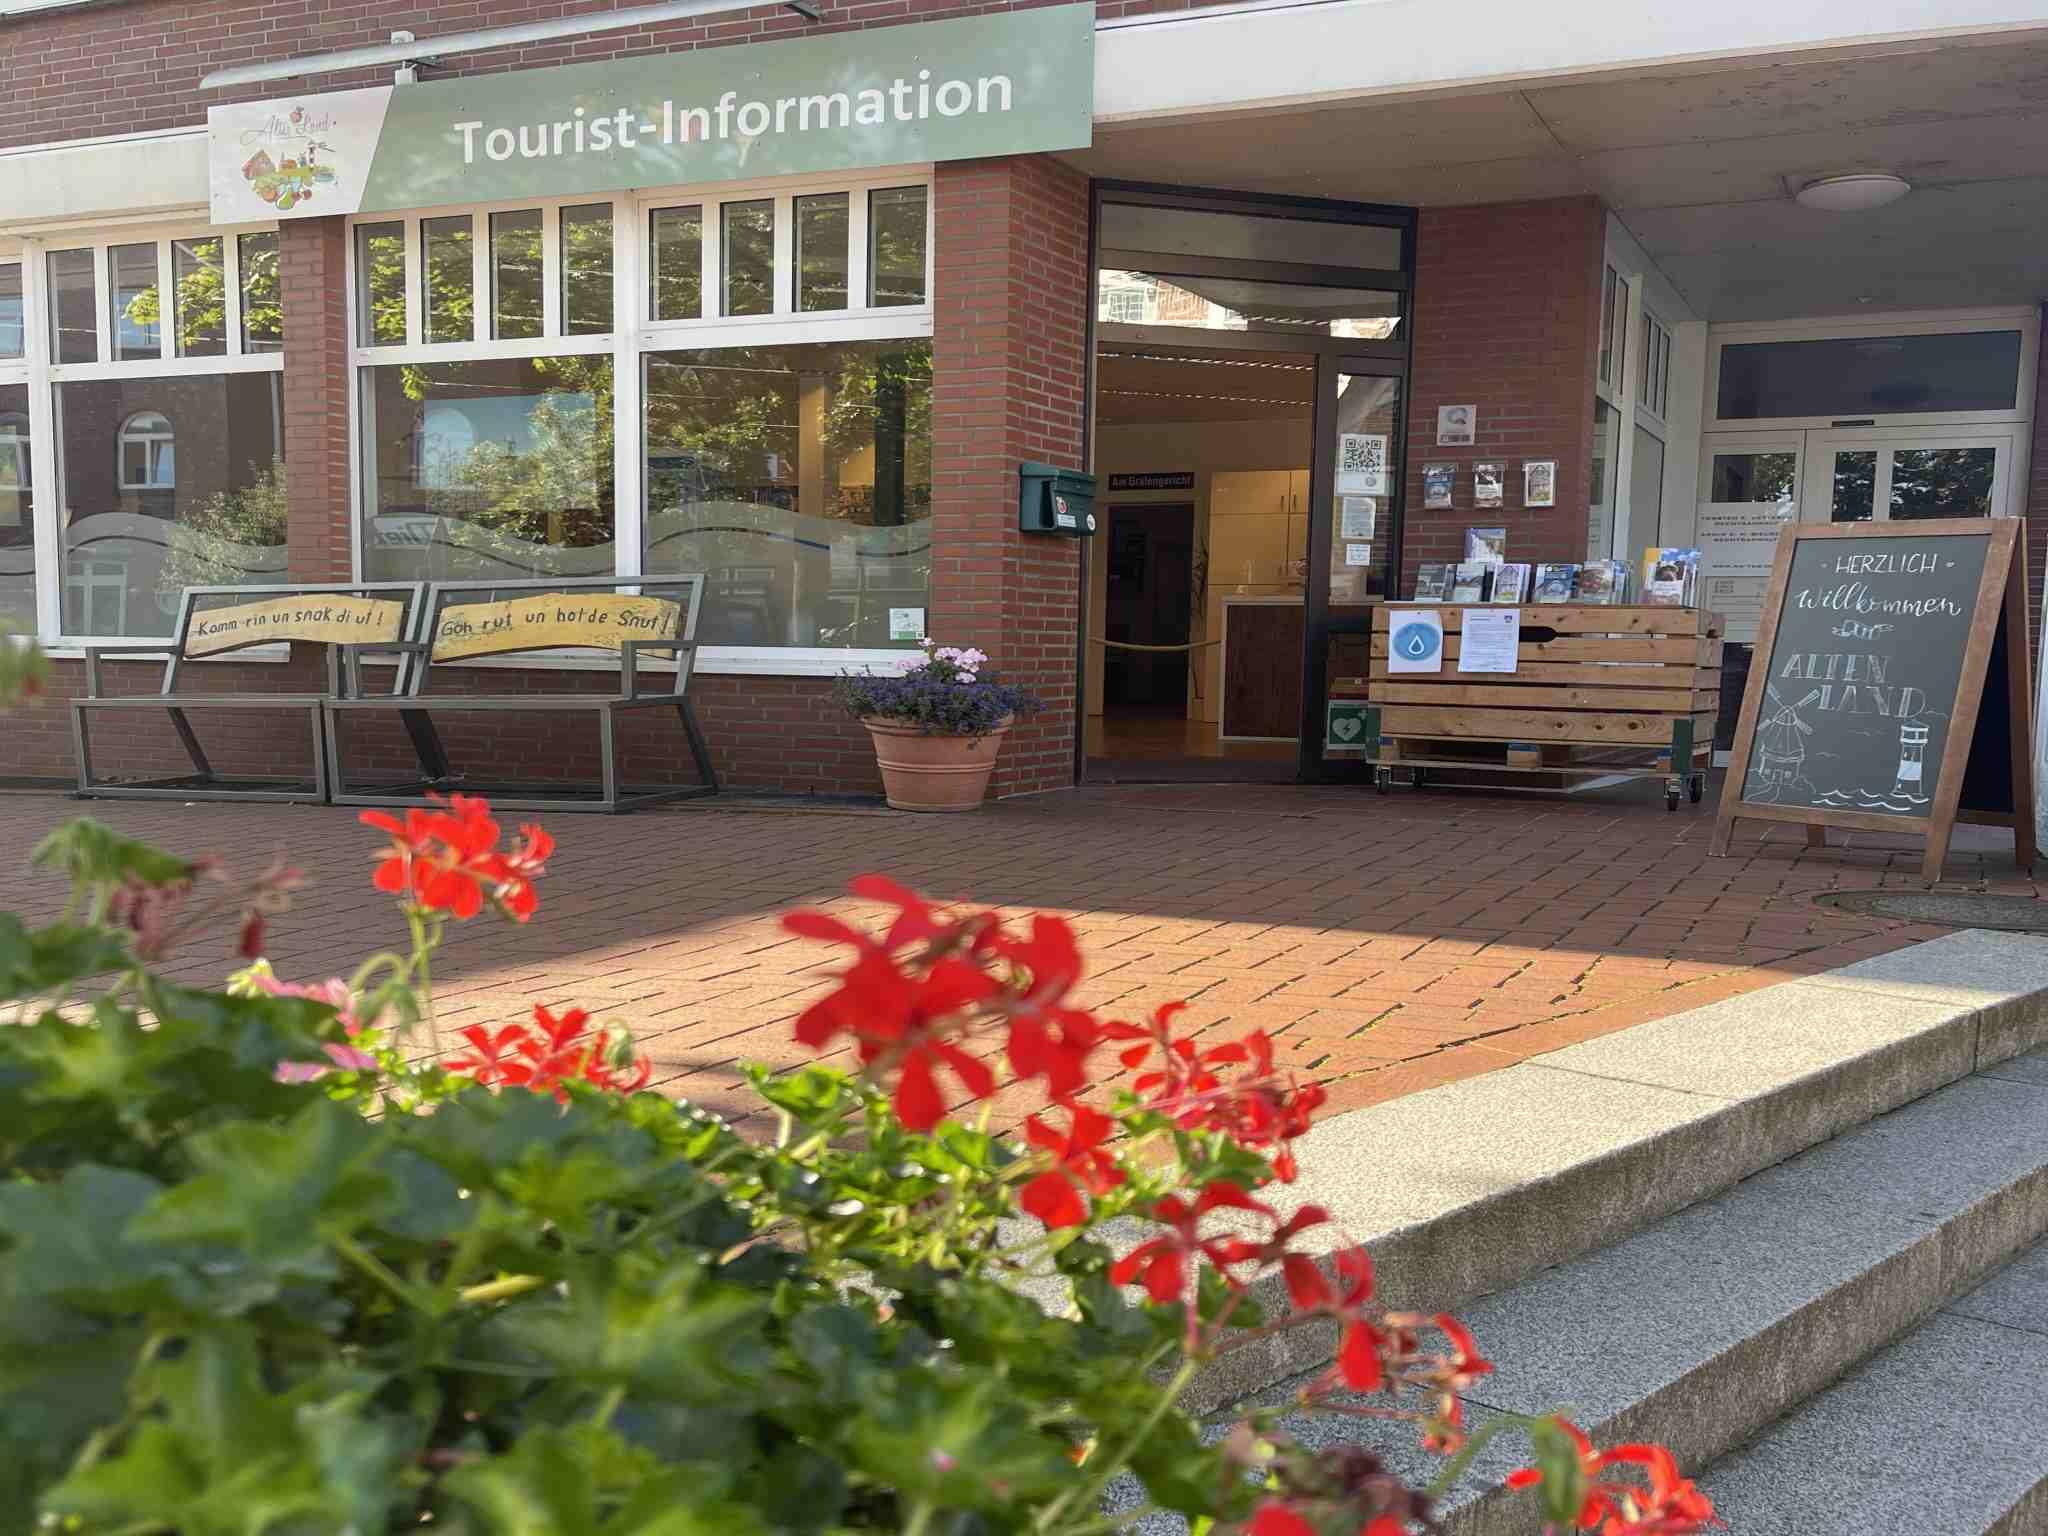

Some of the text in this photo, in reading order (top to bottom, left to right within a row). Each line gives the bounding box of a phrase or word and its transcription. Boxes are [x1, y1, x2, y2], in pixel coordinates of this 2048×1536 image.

[453, 69, 1012, 164] Tourist-Information
[1835, 553, 1938, 575] HERZLICH
[1795, 582, 1961, 617] Willkommen
[199, 620, 238, 636] Komm
[245, 614, 266, 627] rin
[272, 612, 289, 624] un
[525, 612, 545, 623] un
[1780, 653, 1891, 684] ALTEN
[1817, 684, 1927, 718] LAND
